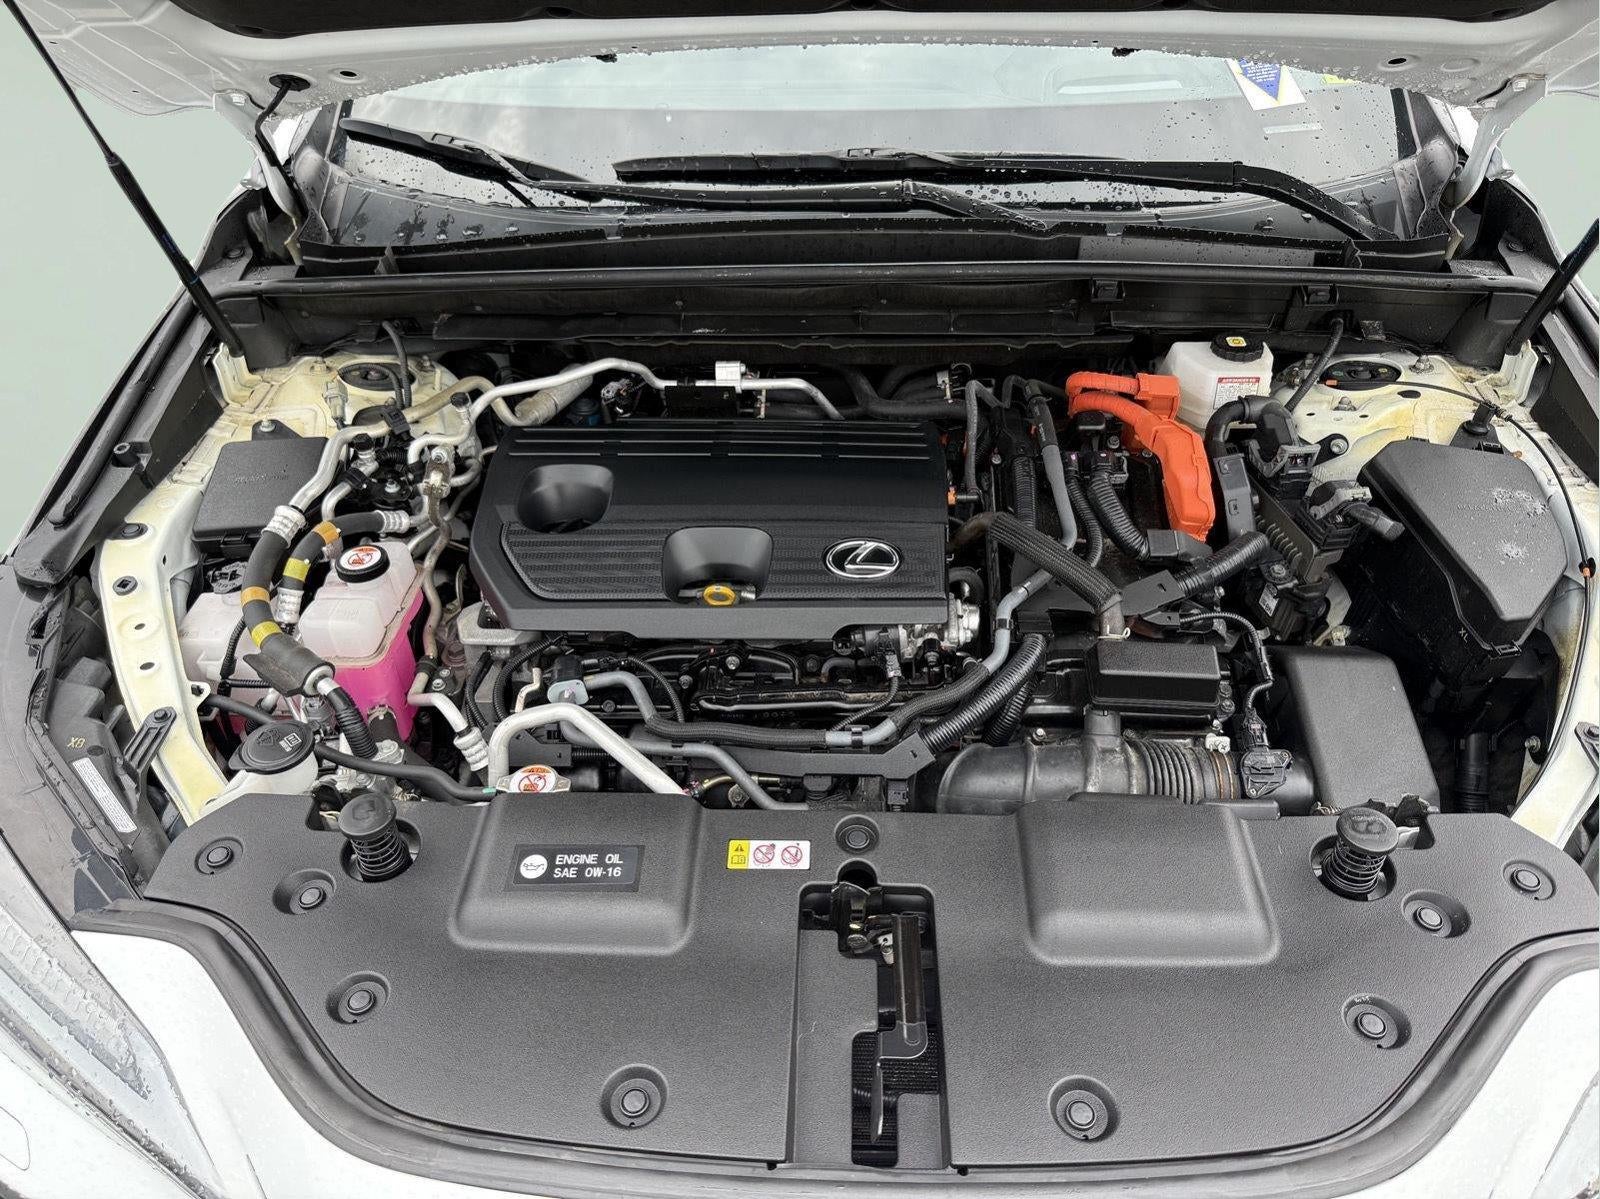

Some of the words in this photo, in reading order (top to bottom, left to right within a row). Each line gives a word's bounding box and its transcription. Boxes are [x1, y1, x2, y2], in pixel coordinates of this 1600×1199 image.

[555, 854, 599, 865] ENGINE
[605, 853, 624, 864] OIL
[553, 867, 578, 878] SAE
[585, 867, 622, 878] 0W-16
